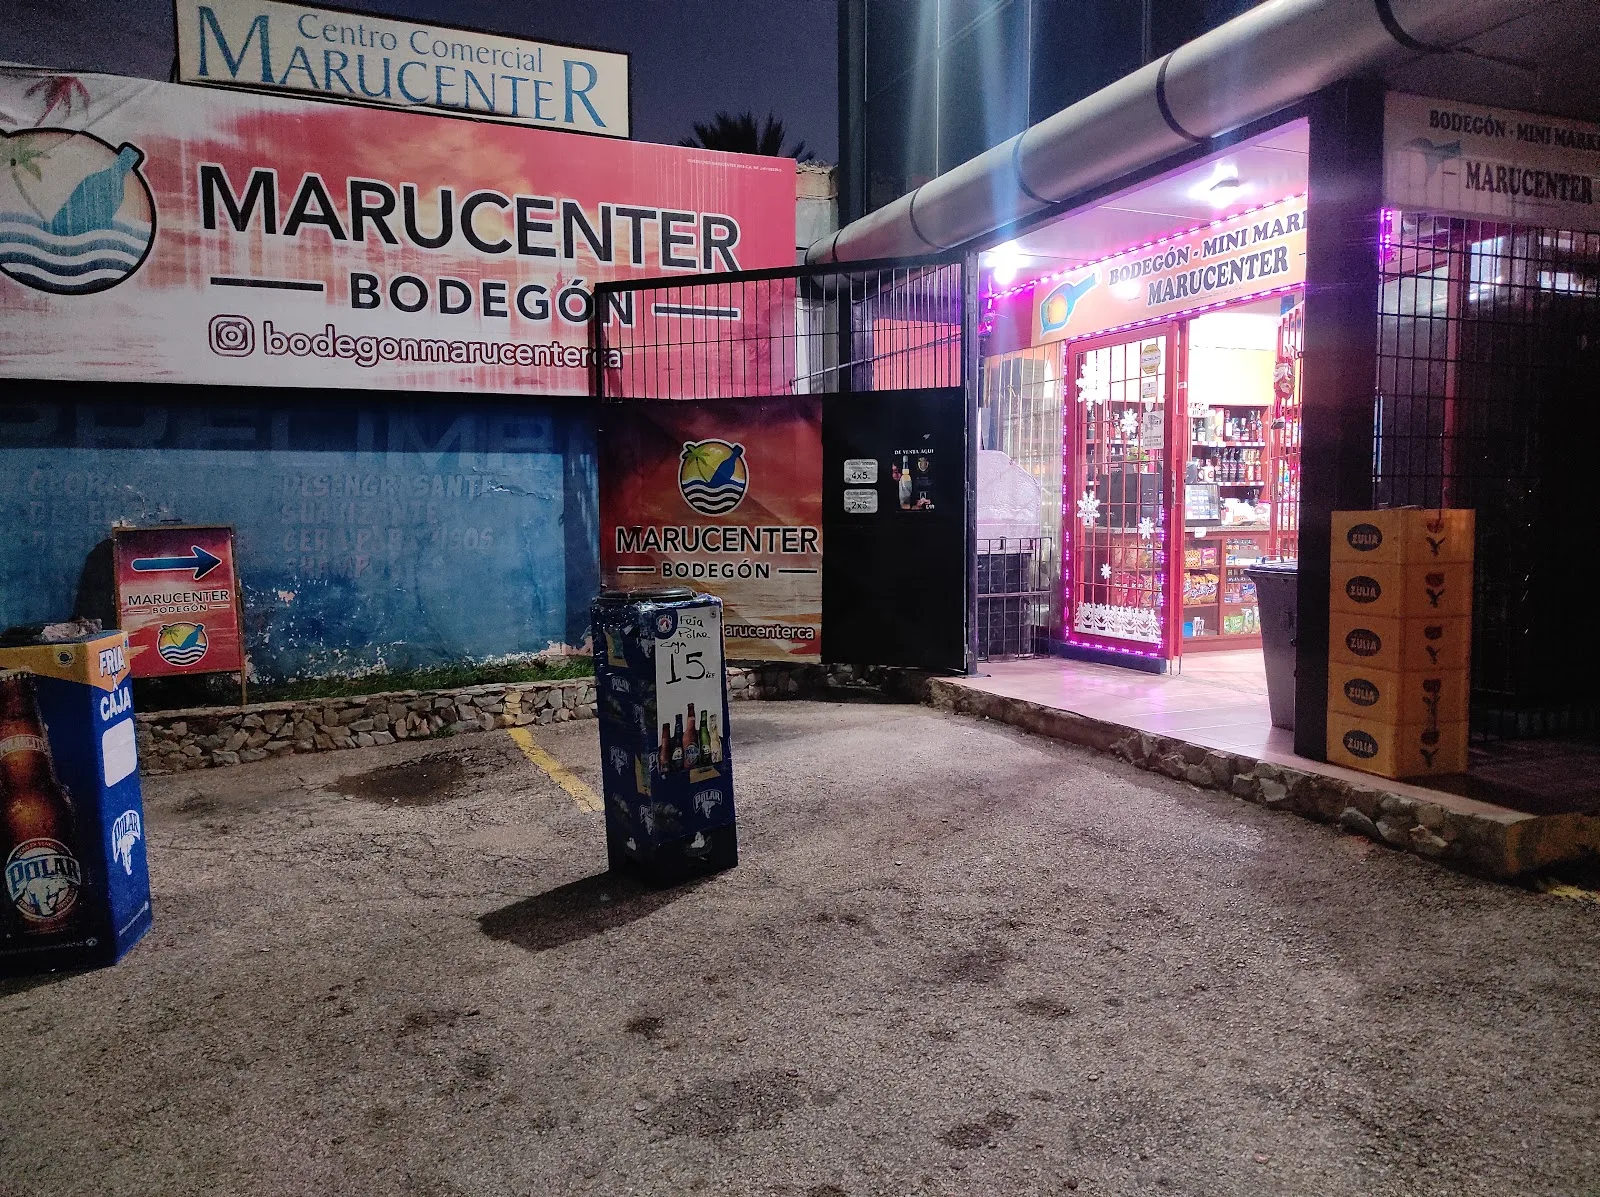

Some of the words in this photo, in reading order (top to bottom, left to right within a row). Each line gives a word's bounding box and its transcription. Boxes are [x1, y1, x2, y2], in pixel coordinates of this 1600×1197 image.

[298, 13, 398, 51] Centro
[409, 30, 543, 73] Comercial
[199, 6, 607, 127] MARUCENTER
[1465, 161, 1593, 204] MARUCENTER
[202, 165, 741, 271] MARUCENTER
[1109, 246, 1190, 286] BODEGÓN
[1202, 228, 1248, 260] MINI
[1252, 210, 1307, 243] MAR
[1147, 246, 1288, 306] MARUCENTER
[352, 273, 633, 326] BODEGÓN
[616, 527, 818, 553] MARUCENTER
[1351, 533, 1378, 546] ZULIA
[662, 560, 770, 579] BODEGÓN
[128, 590, 229, 606] MARUCENTER
[1350, 584, 1377, 598] ZULIA
[152, 604, 207, 614] BODEGÓN
[1350, 637, 1377, 651] ZULIA
[99, 645, 126, 677] FRIA
[666, 651, 706, 685] 15
[100, 686, 131, 721] CAJA
[1348, 687, 1375, 701] ZULIA
[1347, 738, 1373, 753] ZULIA
[695, 790, 720, 809] POLAR
[113, 811, 139, 854] POLAR
[8, 857, 79, 896] POLAR
